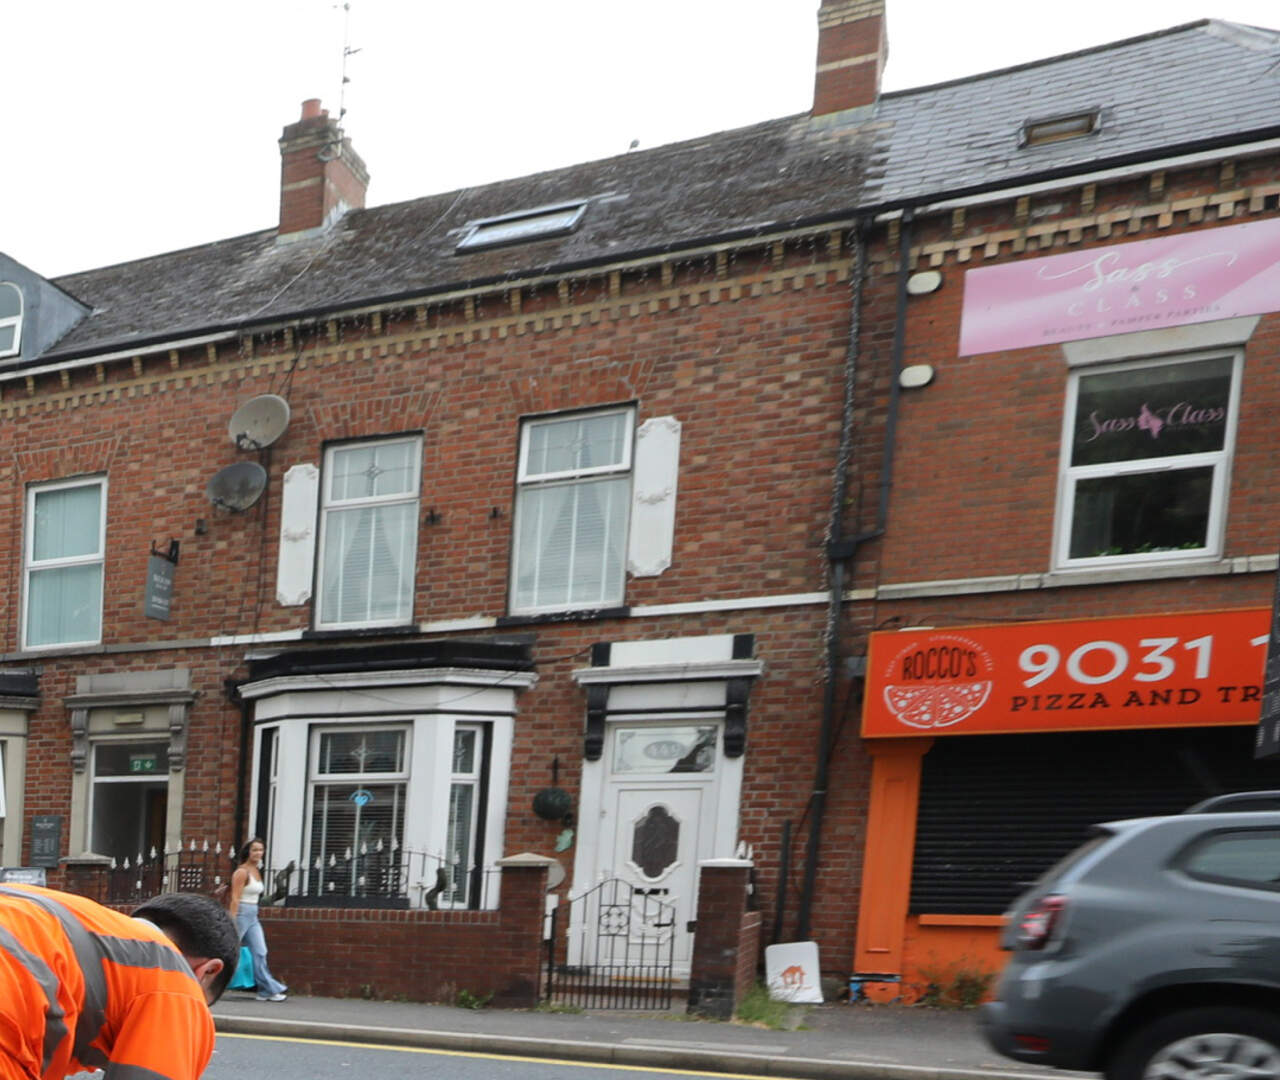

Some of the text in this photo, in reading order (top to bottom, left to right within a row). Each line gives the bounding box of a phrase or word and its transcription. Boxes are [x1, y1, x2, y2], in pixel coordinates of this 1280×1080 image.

[1067, 285, 1197, 316] CLASS
[1086, 400, 1226, 442] Sass Class
[902, 646, 977, 681] ROCCO'S
[1018, 634, 1214, 689] 9031
[1010, 692, 1110, 712] PIZZA
[1123, 687, 1202, 708] AND
